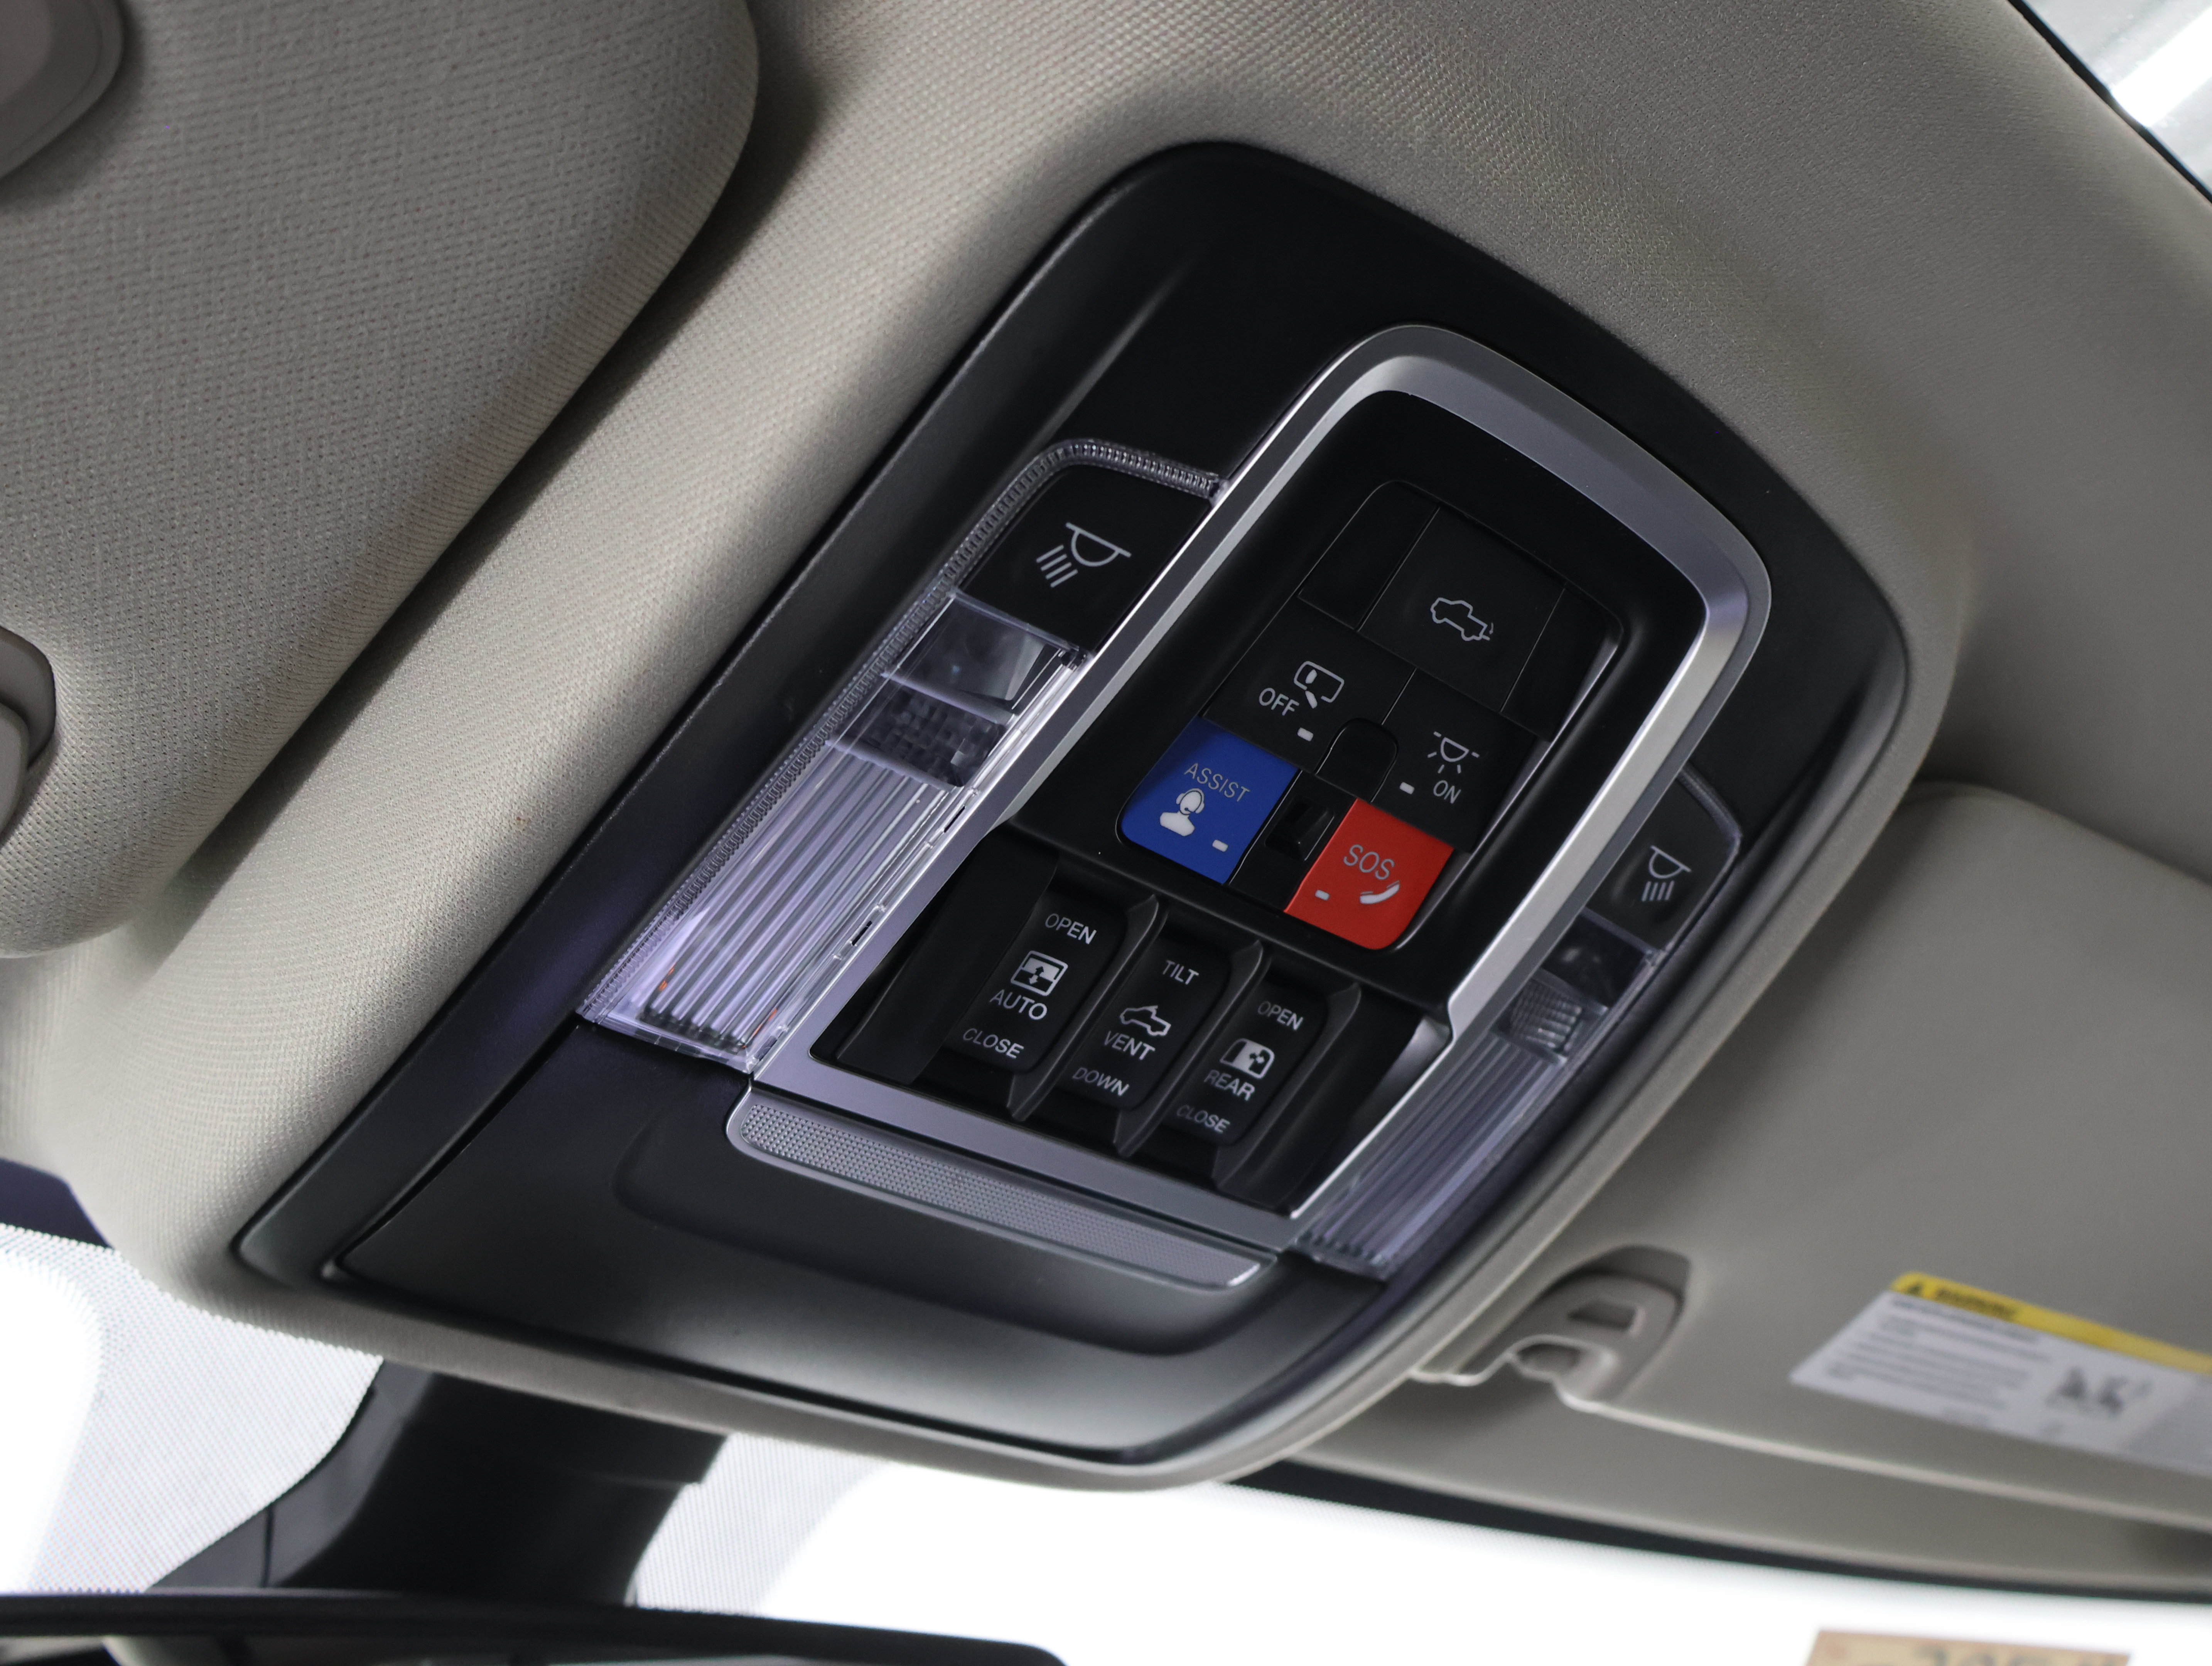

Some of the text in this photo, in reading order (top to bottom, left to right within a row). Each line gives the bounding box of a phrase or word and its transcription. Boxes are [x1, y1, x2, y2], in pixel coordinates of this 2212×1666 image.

[1259, 687, 1299, 716] OFF
[1184, 763, 1250, 802] ASSIST
[1433, 780, 1461, 804] ON
[1343, 844, 1395, 880] SOS
[1044, 913, 1097, 944] OPEN
[1163, 959, 1199, 985] TILT
[990, 988, 1048, 1020] AUTO
[1257, 1001, 1304, 1031] OPEN
[963, 1028, 1024, 1059] CLOSE
[1104, 1030, 1156, 1061] VENT
[1071, 1066, 1130, 1096] DOWN
[1204, 1069, 1255, 1101] REAR
[1176, 1104, 1231, 1134] CLOSE
